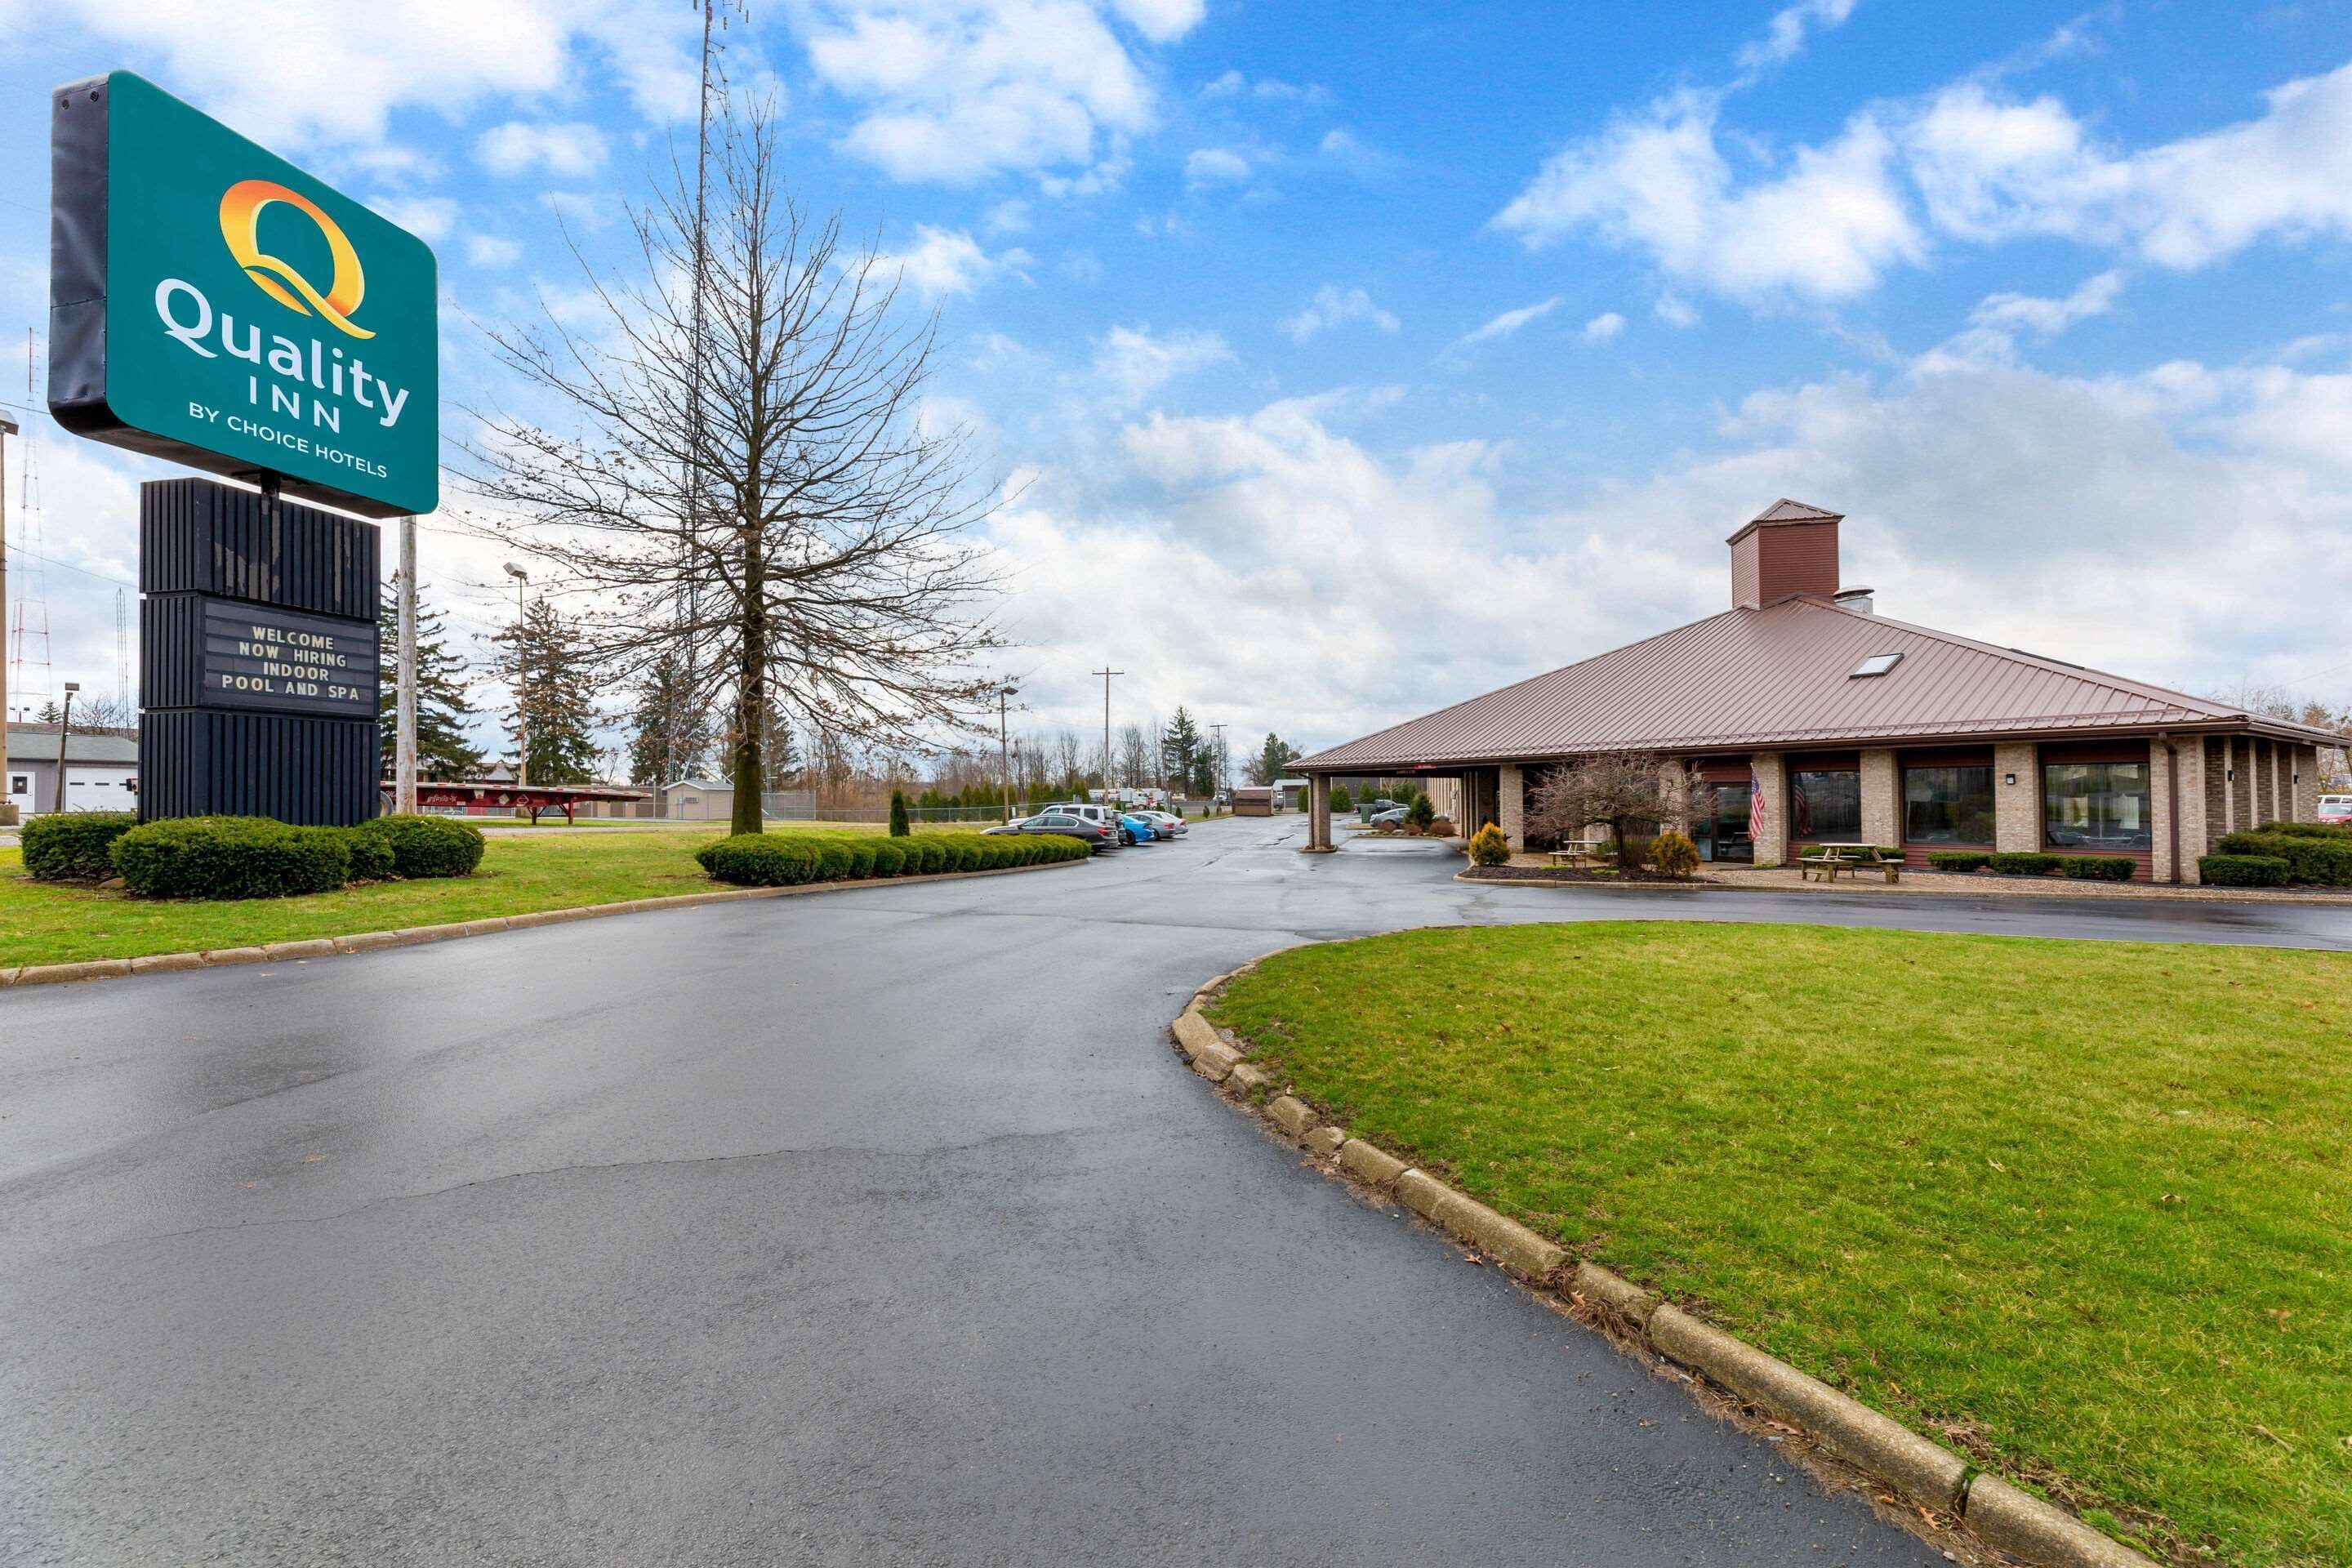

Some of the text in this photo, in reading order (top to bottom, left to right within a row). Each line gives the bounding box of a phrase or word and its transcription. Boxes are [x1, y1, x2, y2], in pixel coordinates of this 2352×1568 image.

[154, 278, 410, 426] Quality
[249, 376, 341, 434] INN
[189, 403, 388, 479] BY CHOICE HOTELS
[252, 626, 334, 649] WELCOME
[239, 642, 346, 667] NOW HIRING
[263, 662, 329, 681] INDOOR
[221, 675, 359, 701] POOL AND SPA
